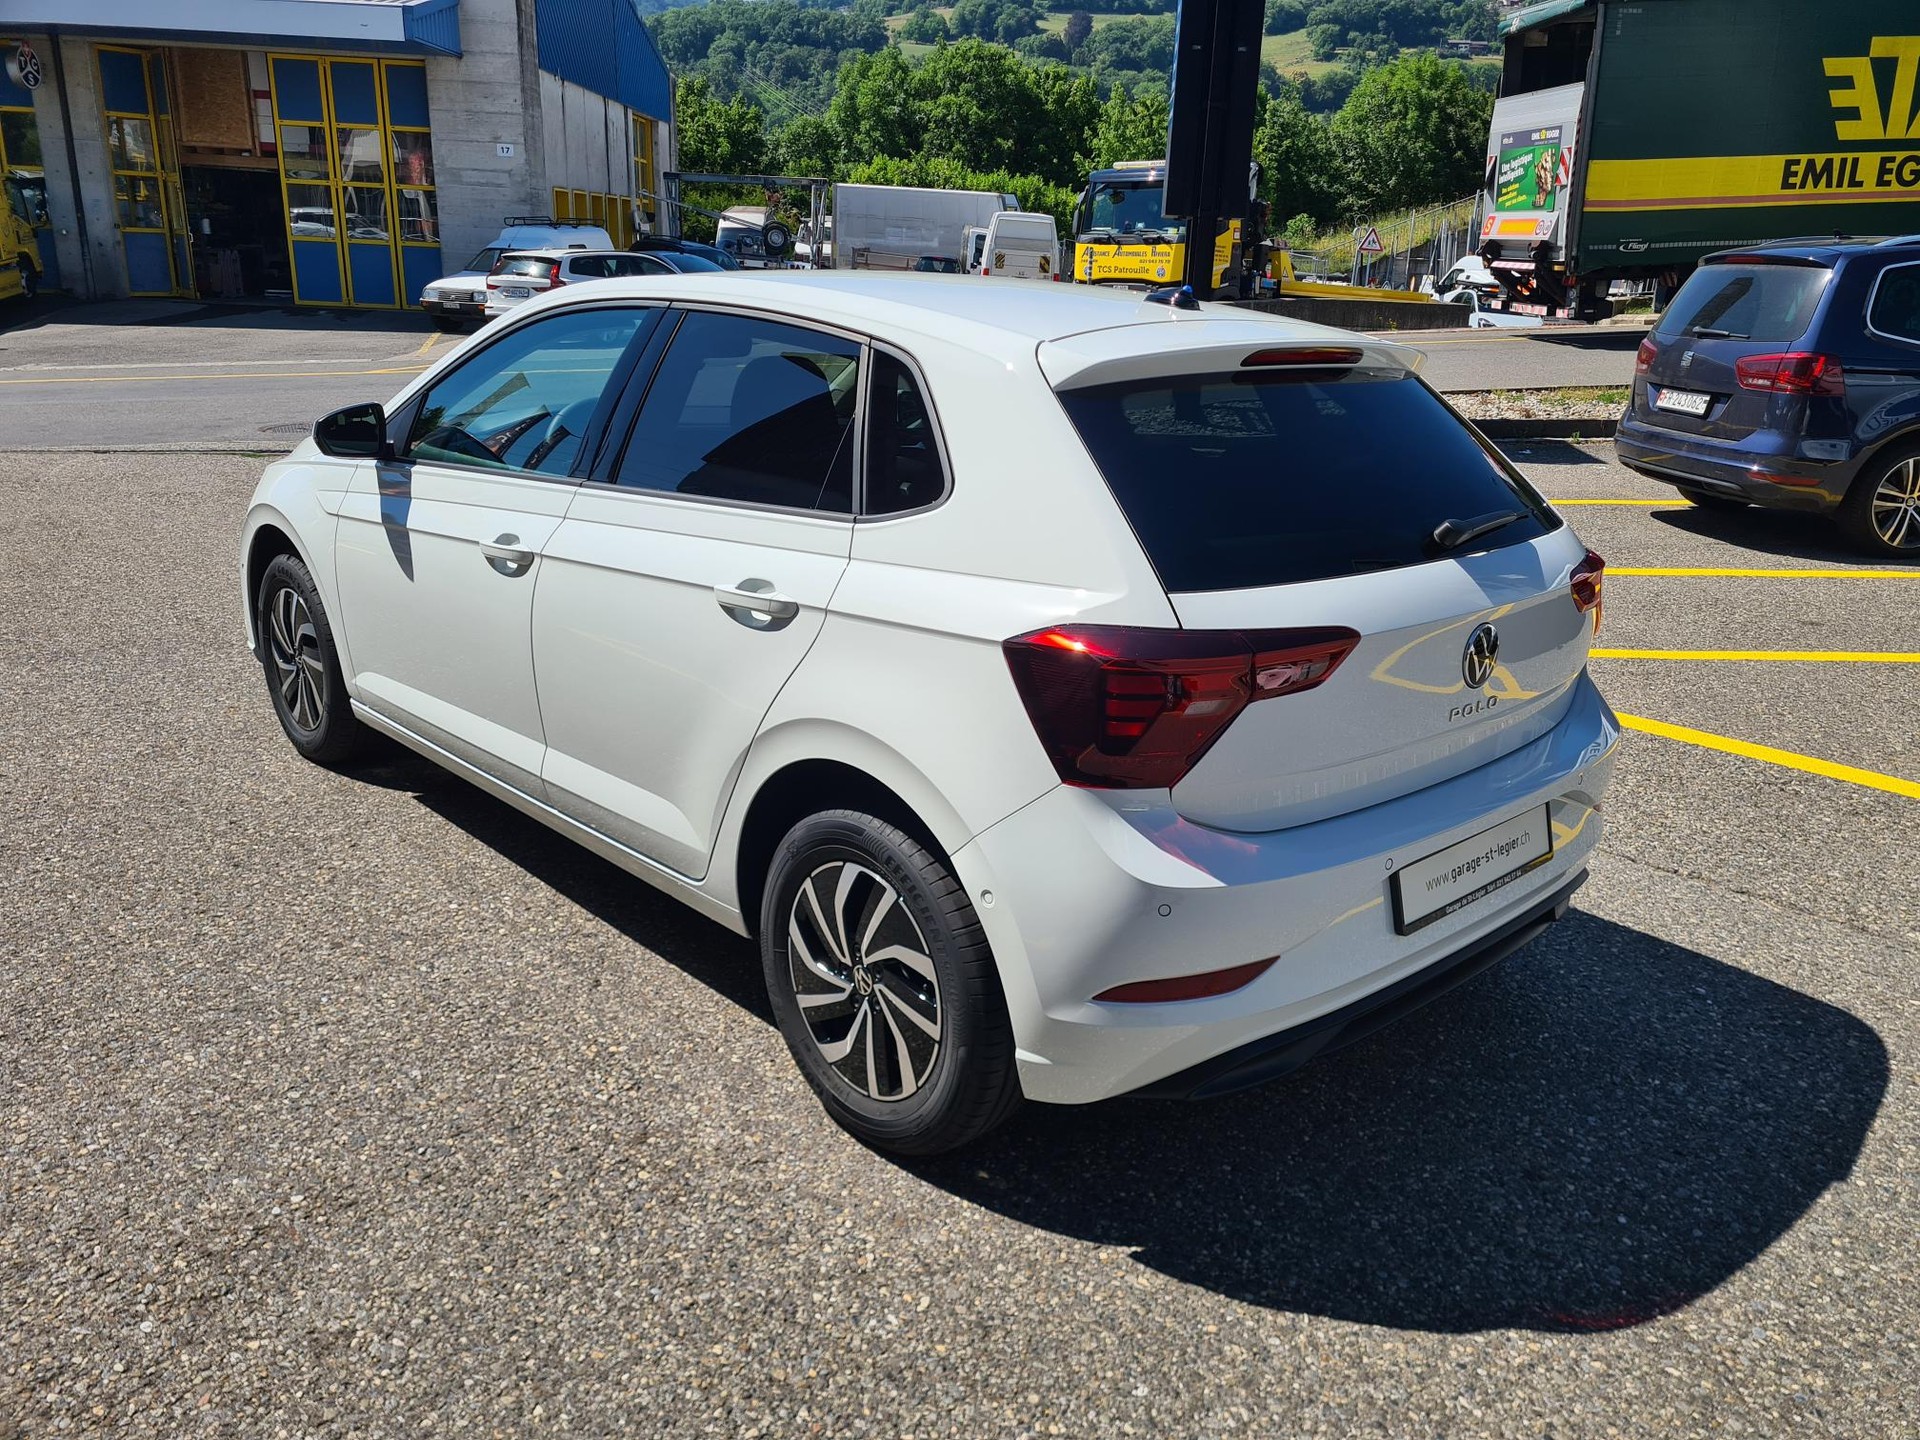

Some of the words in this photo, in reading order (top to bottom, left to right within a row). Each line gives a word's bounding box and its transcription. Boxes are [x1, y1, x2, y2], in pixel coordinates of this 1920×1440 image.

[501, 146, 510, 154] 17
[1780, 157, 1864, 190] EMIL
[1097, 265, 1112, 273] TCS
[1114, 265, 1150, 274] Patrouille
[1449, 695, 1499, 722] POLO
[1425, 830, 1531, 891] www.garage-st-legier.ch
